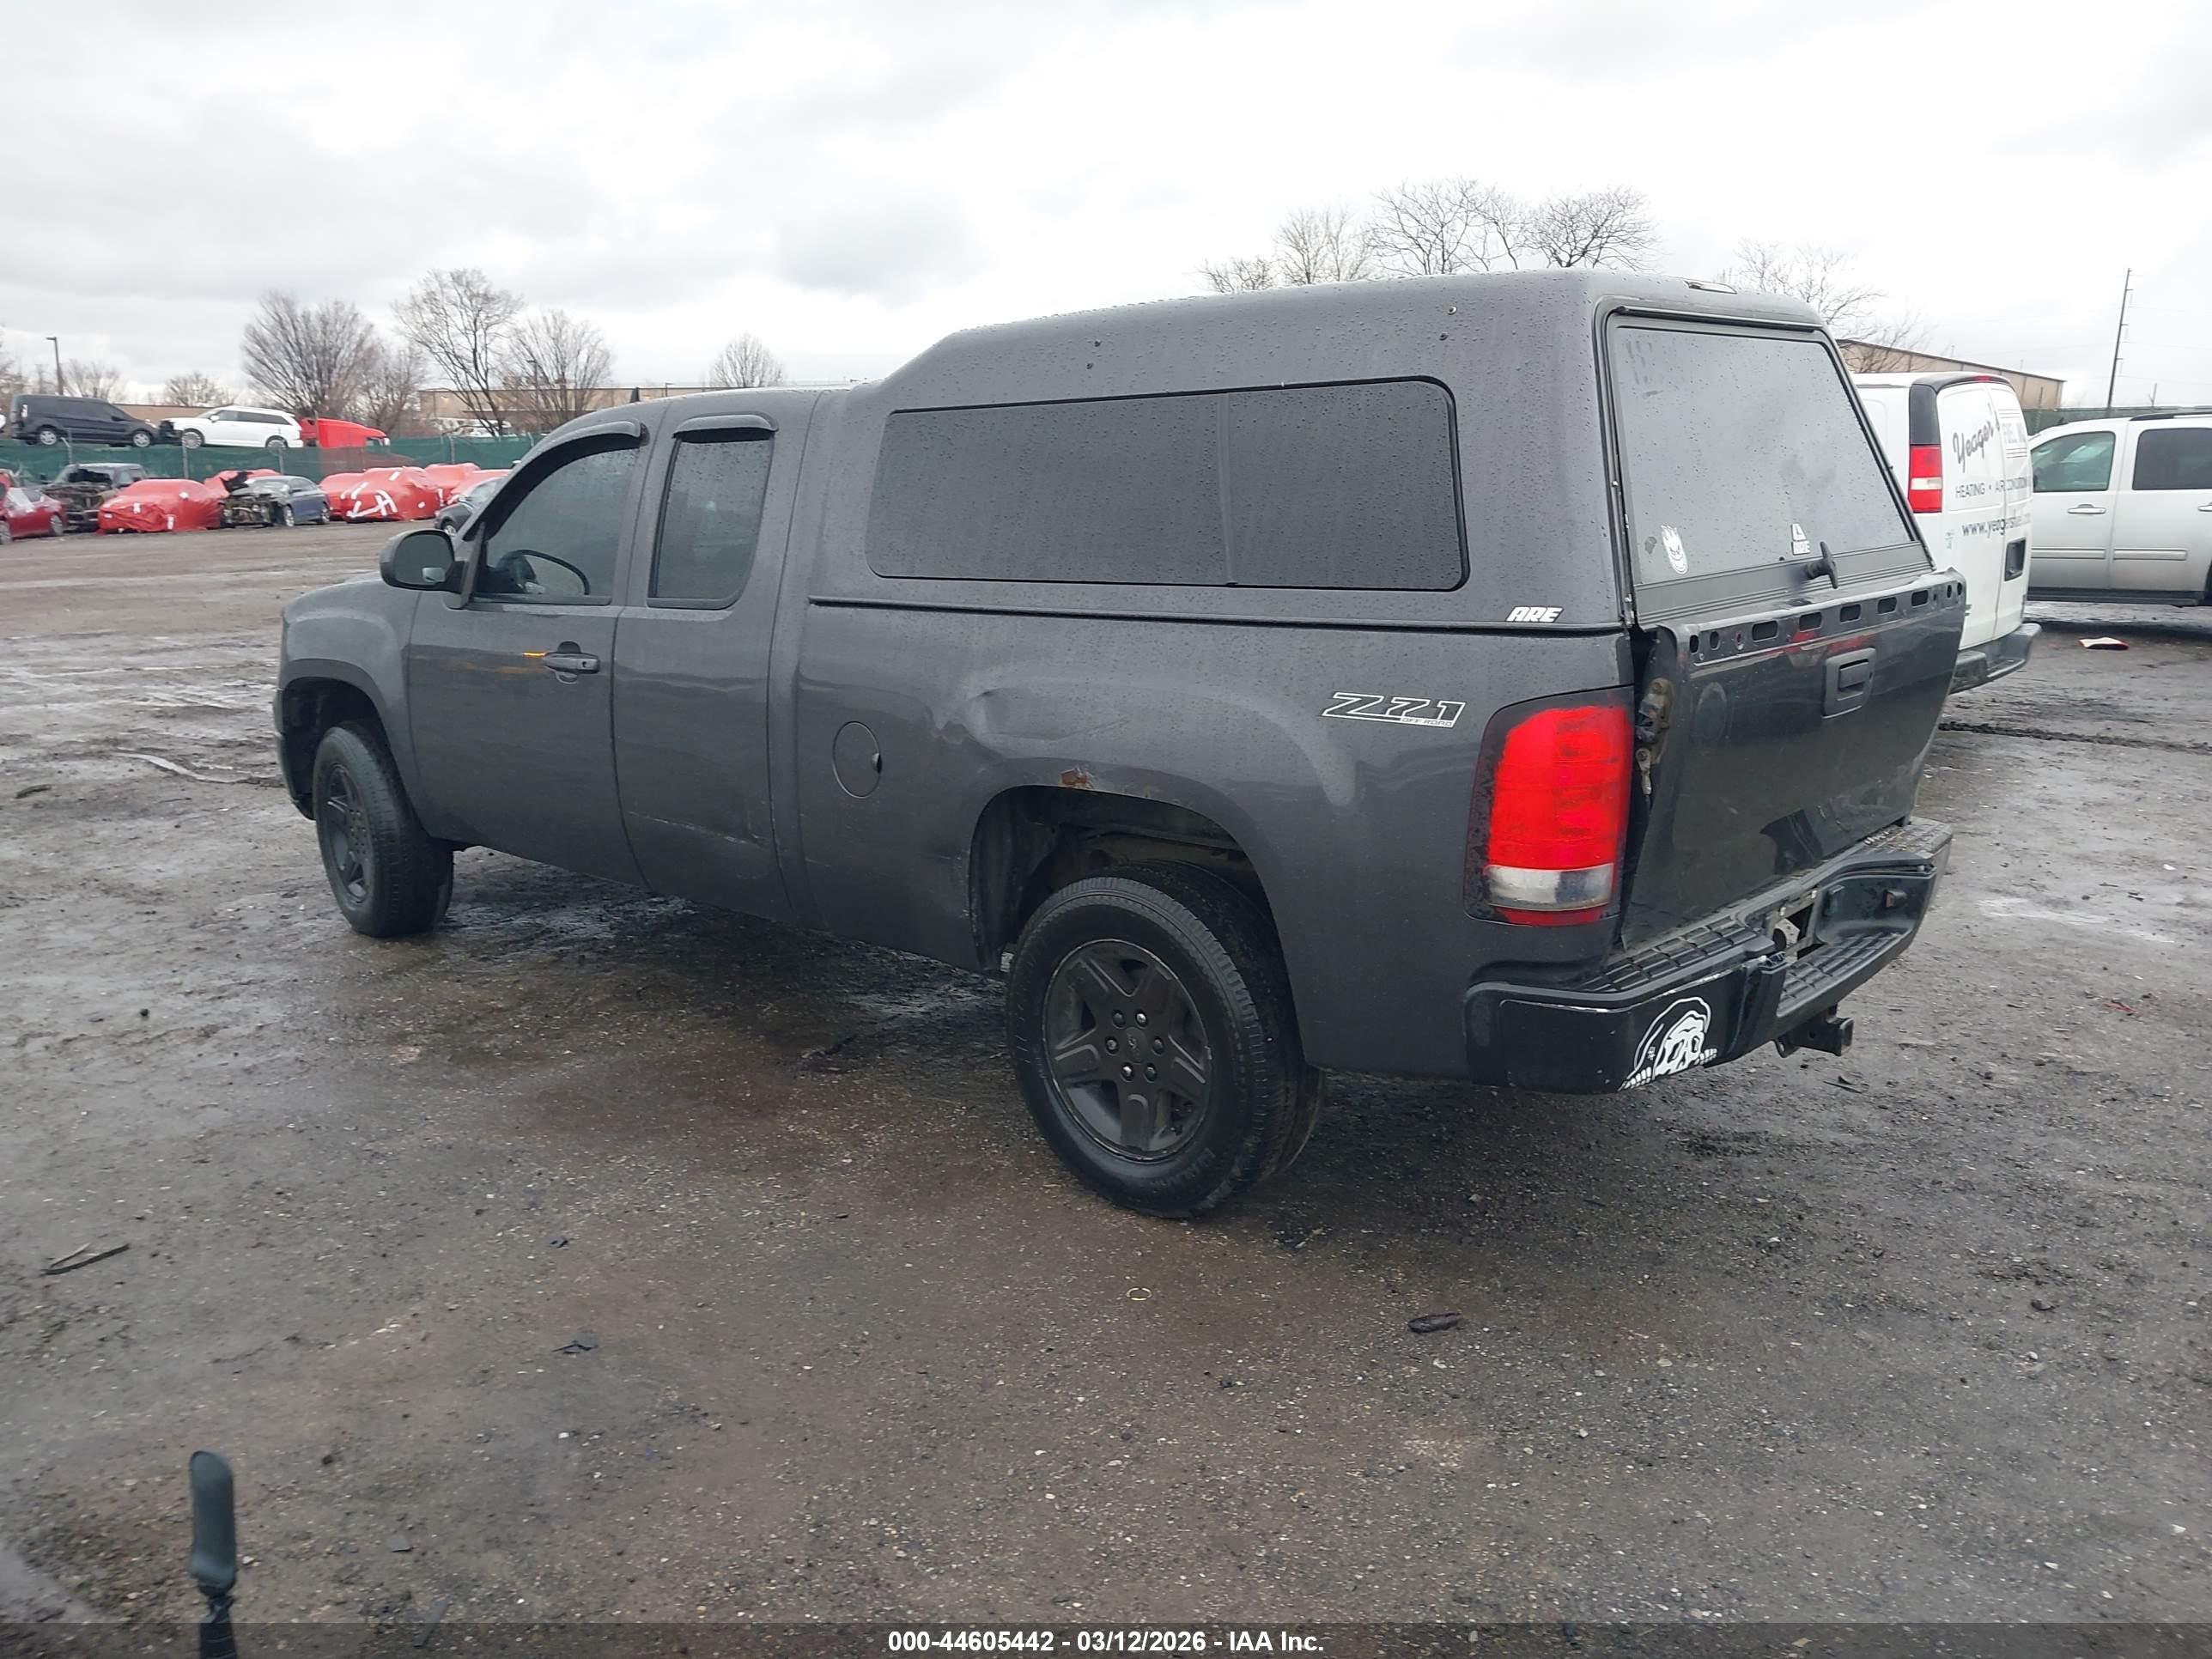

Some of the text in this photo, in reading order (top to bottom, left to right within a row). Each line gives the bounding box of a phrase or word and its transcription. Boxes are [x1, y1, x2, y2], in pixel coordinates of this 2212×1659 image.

[1955, 482, 1986, 498] HEATING
[1505, 606, 1564, 623] ARE
[1322, 691, 1466, 728] Z71
